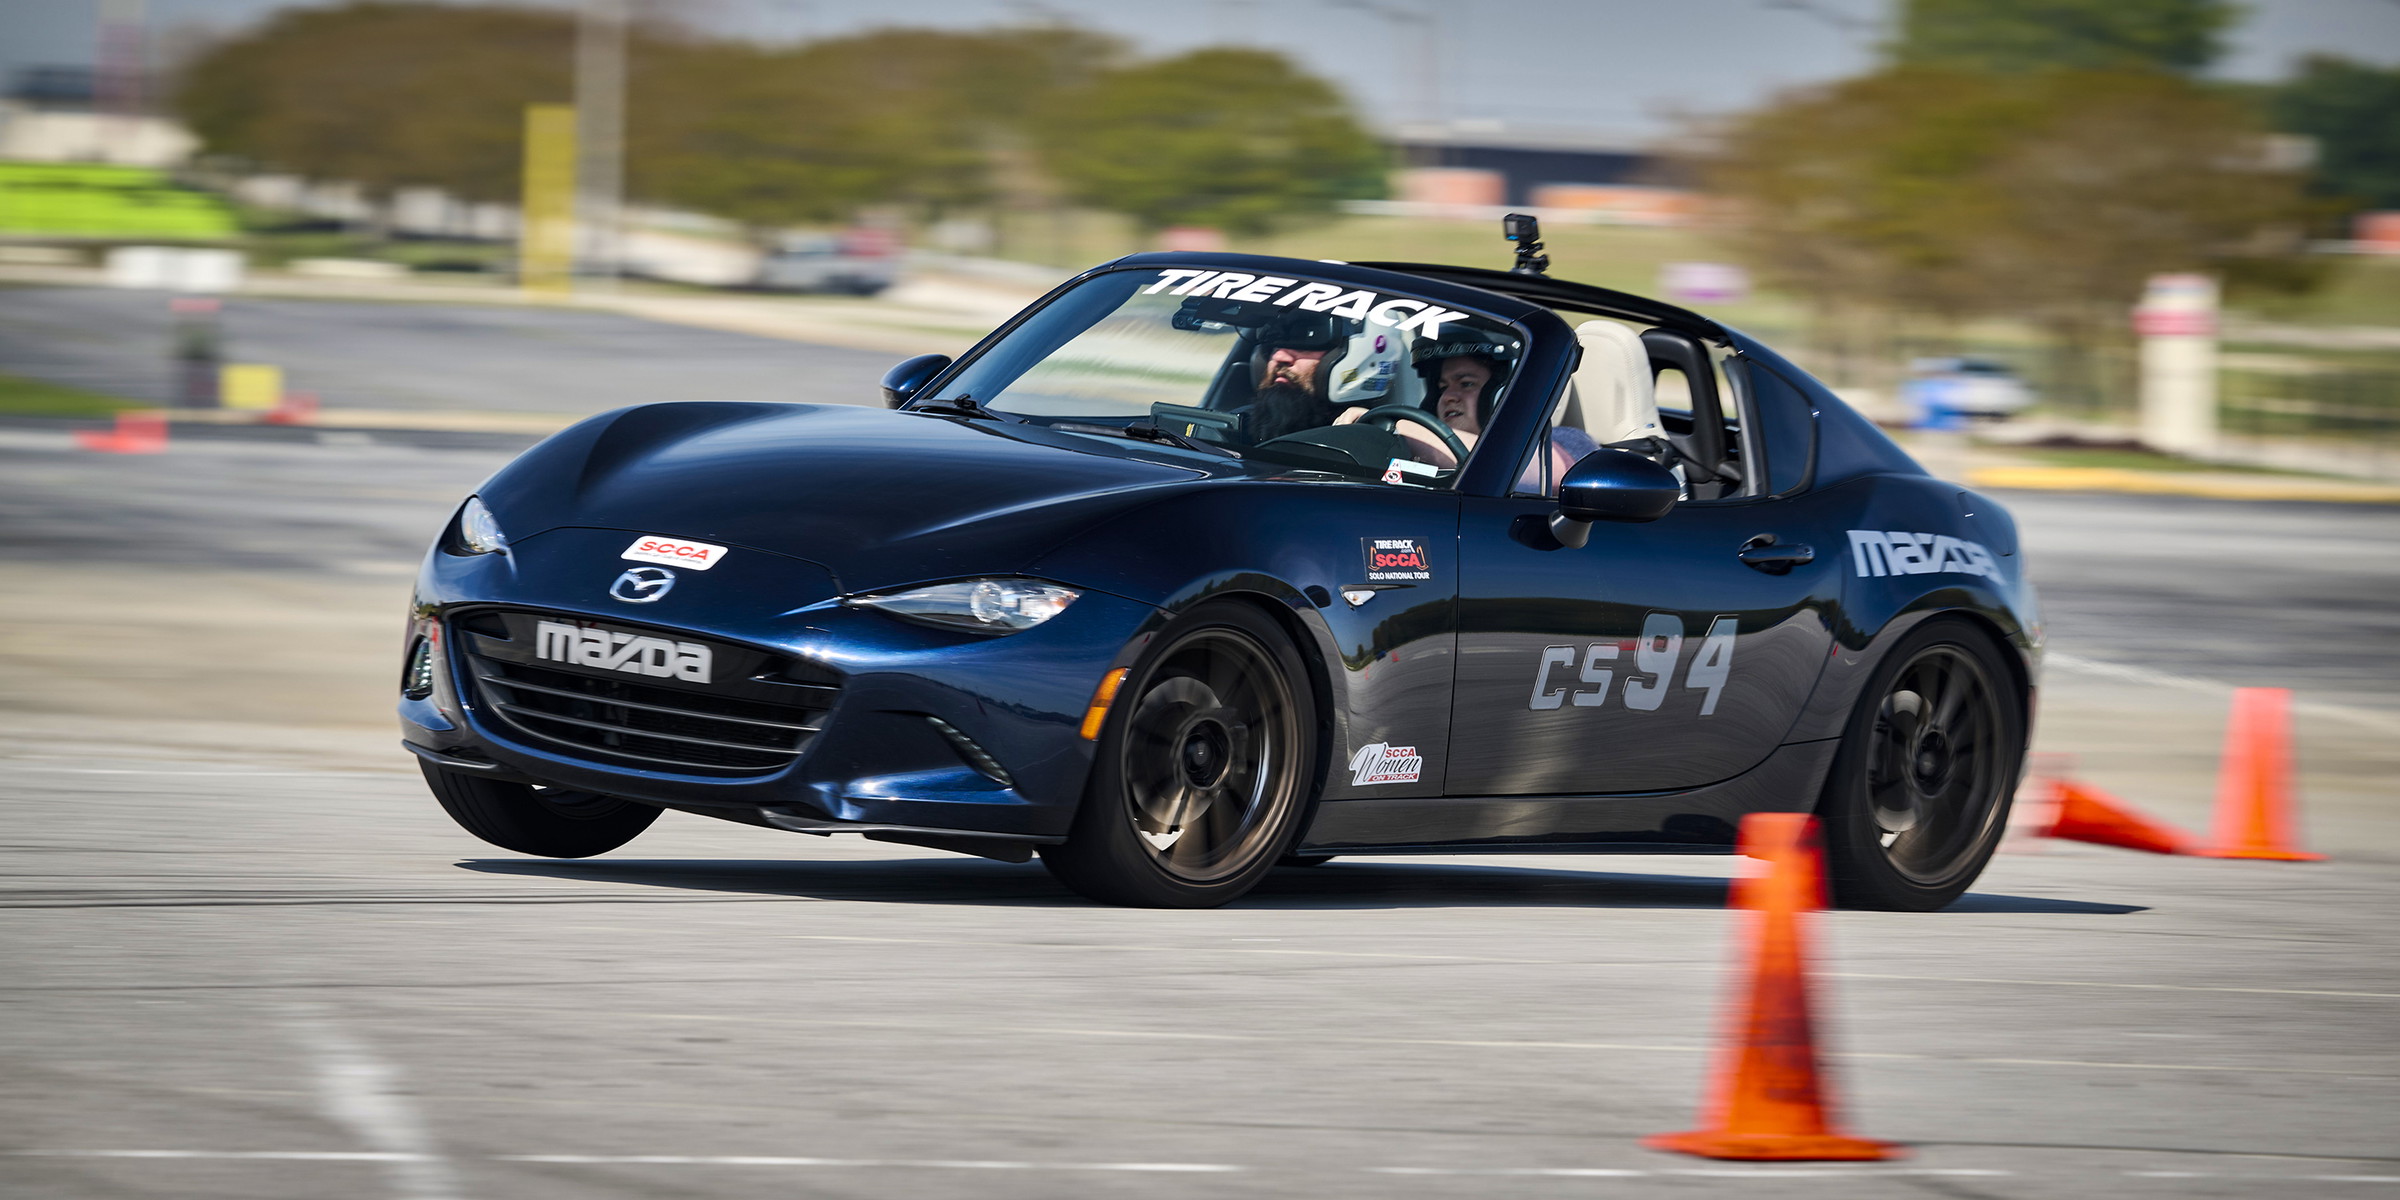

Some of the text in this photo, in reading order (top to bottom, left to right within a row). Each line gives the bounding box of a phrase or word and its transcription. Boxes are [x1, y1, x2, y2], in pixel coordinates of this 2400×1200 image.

[1142, 268, 1470, 340] TIRE RACK
[639, 541, 709, 561] SCCA
[1374, 540, 1416, 553] TIRE RACK
[1375, 553, 1422, 567] SCCA
[1369, 571, 1430, 580] SOLO NATIONAL TOUR
[1385, 748, 1415, 758] SCCA
[1351, 744, 1420, 783] Women
